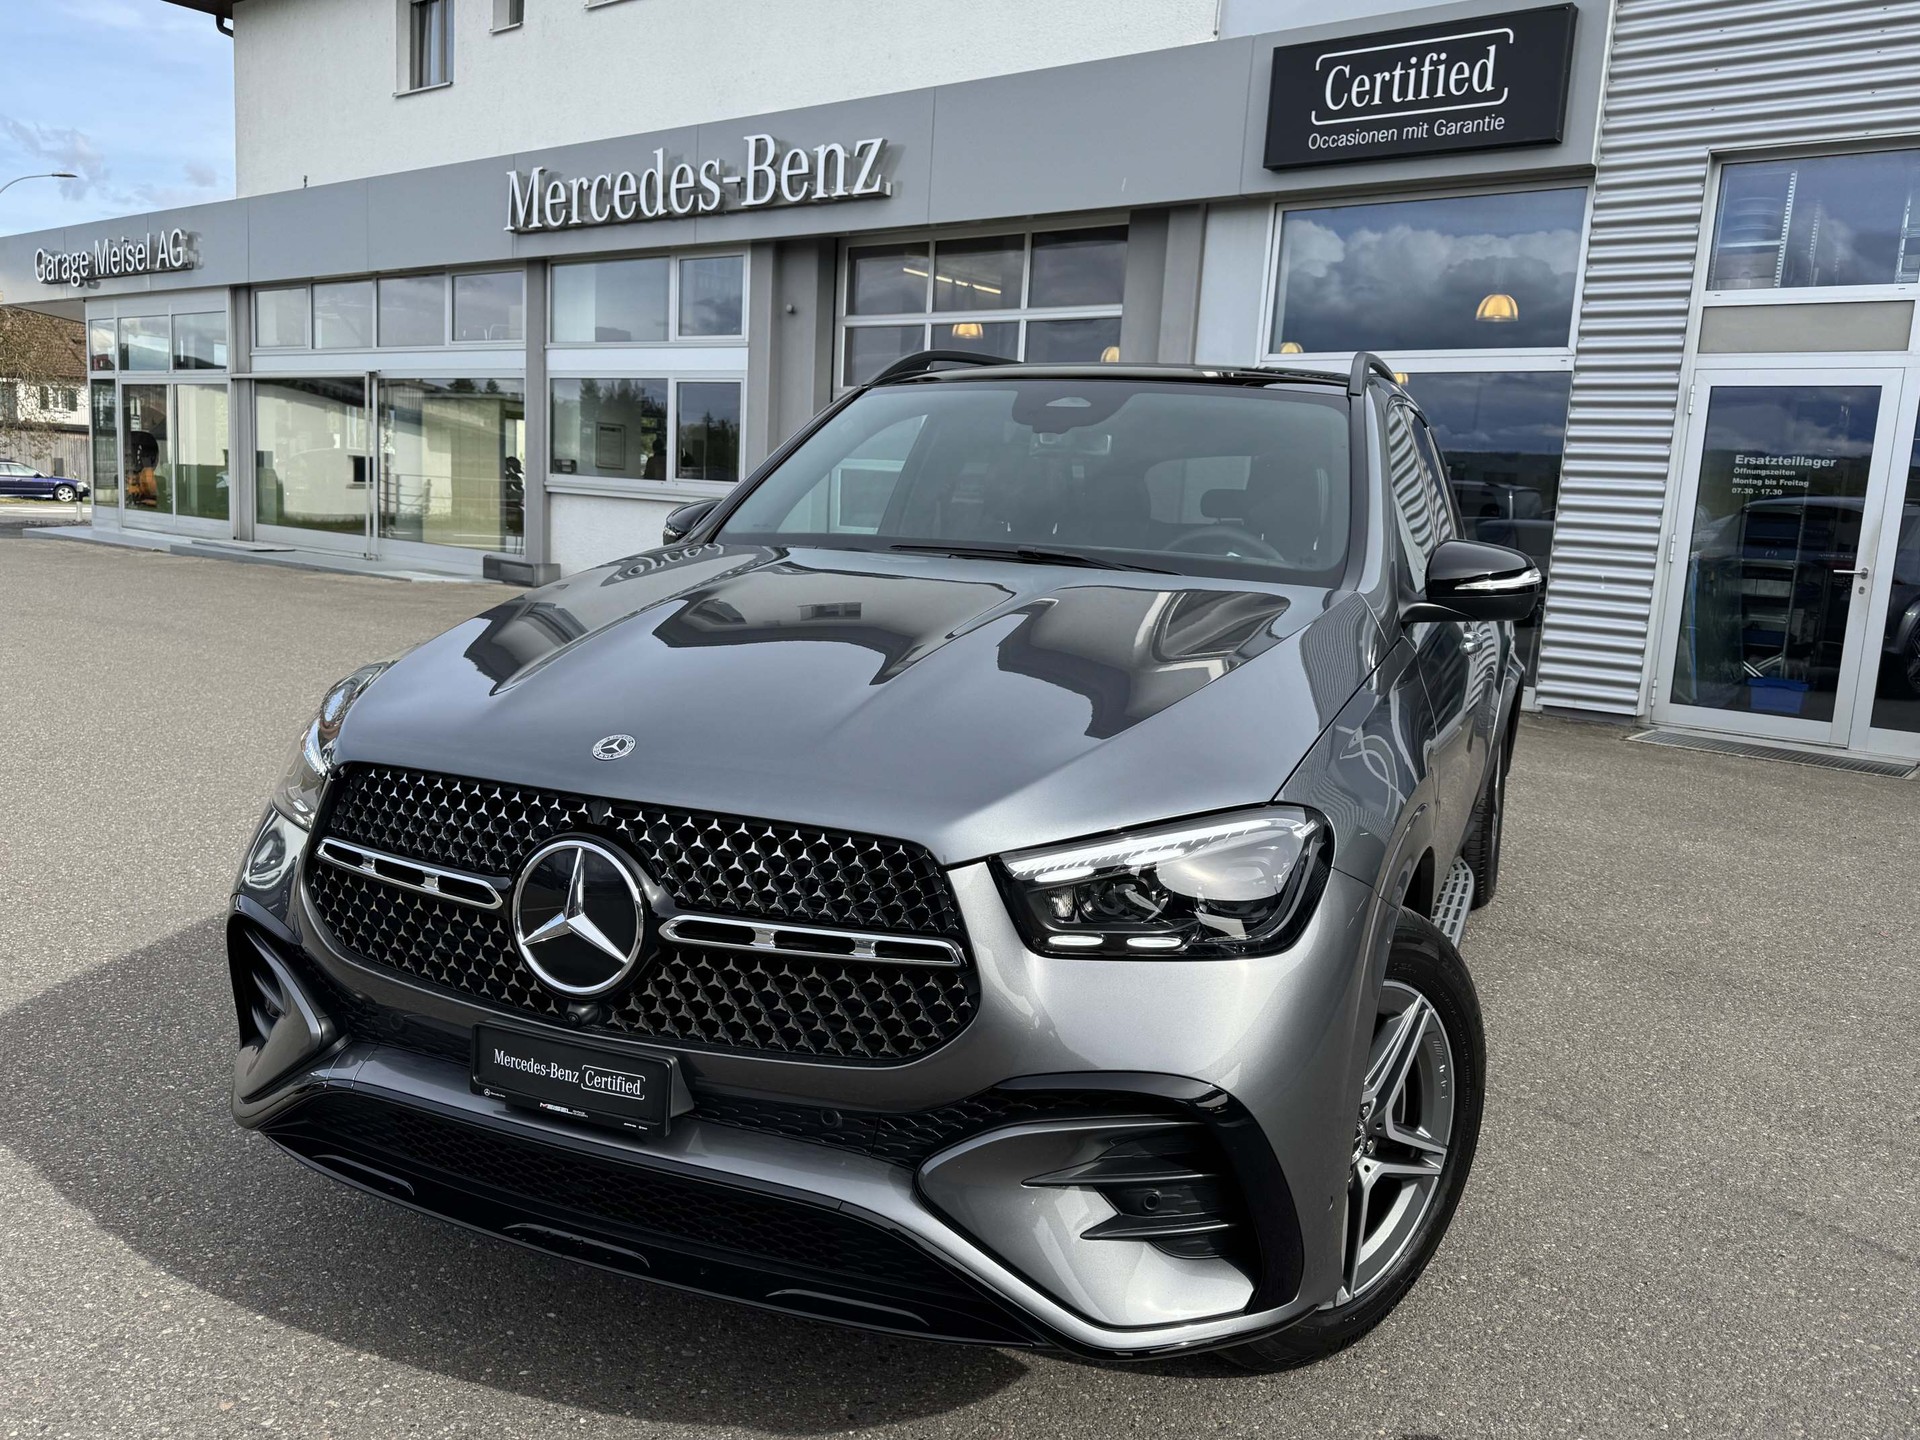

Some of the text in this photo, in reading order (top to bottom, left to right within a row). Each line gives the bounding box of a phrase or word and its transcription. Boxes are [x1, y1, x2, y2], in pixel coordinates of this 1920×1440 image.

[1324, 44, 1497, 111] Certified
[1308, 113, 1505, 150] Occasionen mit Garantie
[503, 133, 886, 232] Mercedes-Benz
[34, 228, 184, 288] Garage Meisel AG
[1733, 466, 1796, 476] Öffnungszeiten
[1735, 454, 1837, 468] Ersatzteillager
[1731, 487, 1754, 495] 07.30
[1760, 488, 1783, 496] 17.30
[1732, 477, 1810, 488] Montag bis Freitag
[493, 1048, 641, 1096] Mercedes-Benz Certified
